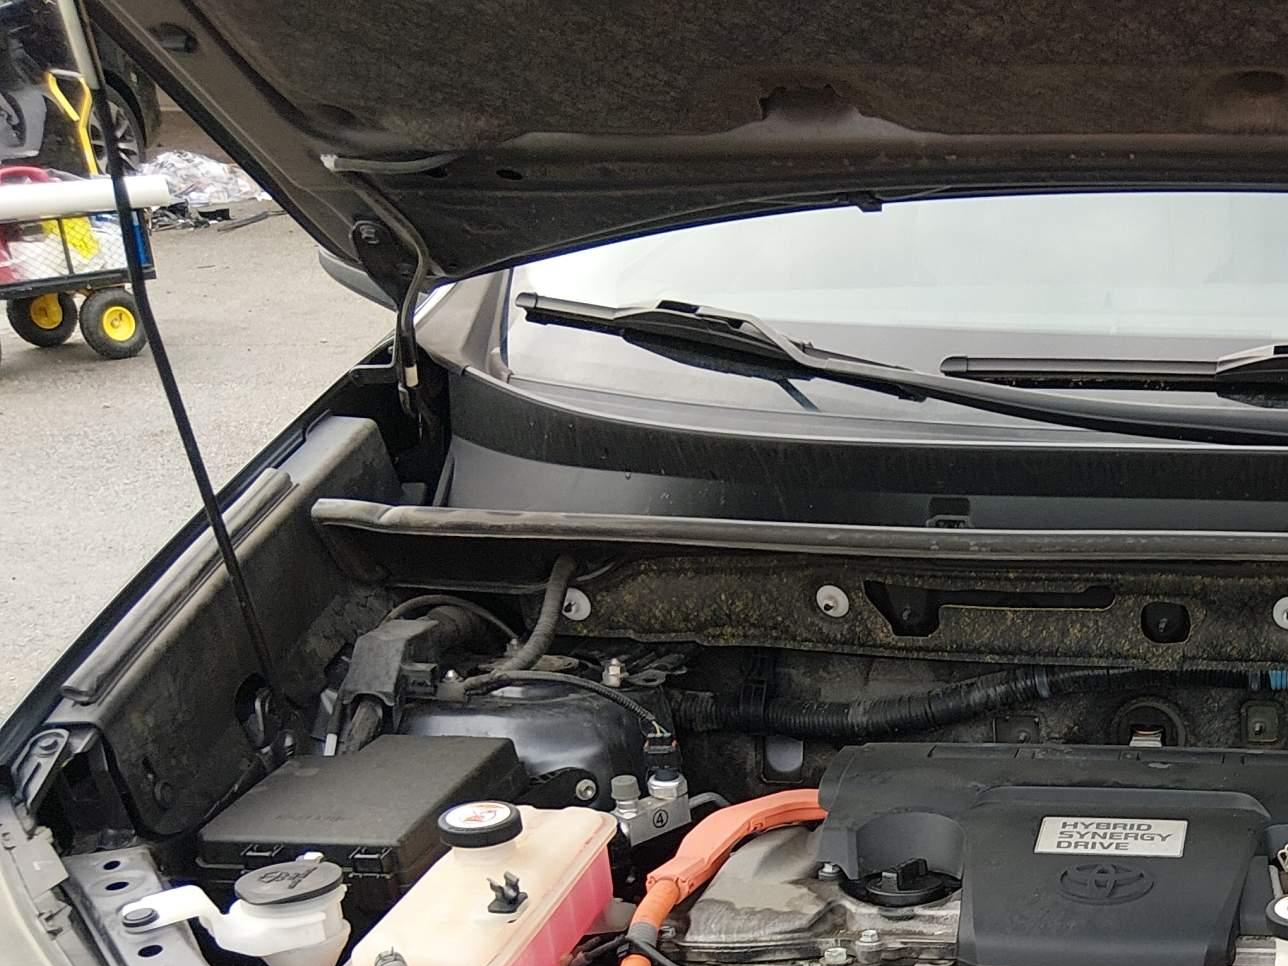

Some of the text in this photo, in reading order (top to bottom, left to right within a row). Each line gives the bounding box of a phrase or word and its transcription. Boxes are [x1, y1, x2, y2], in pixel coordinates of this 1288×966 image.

[1061, 821, 1152, 831] HYBRID
[1058, 831, 1173, 842] SYNERGY
[1056, 840, 1130, 851] DRIVE
